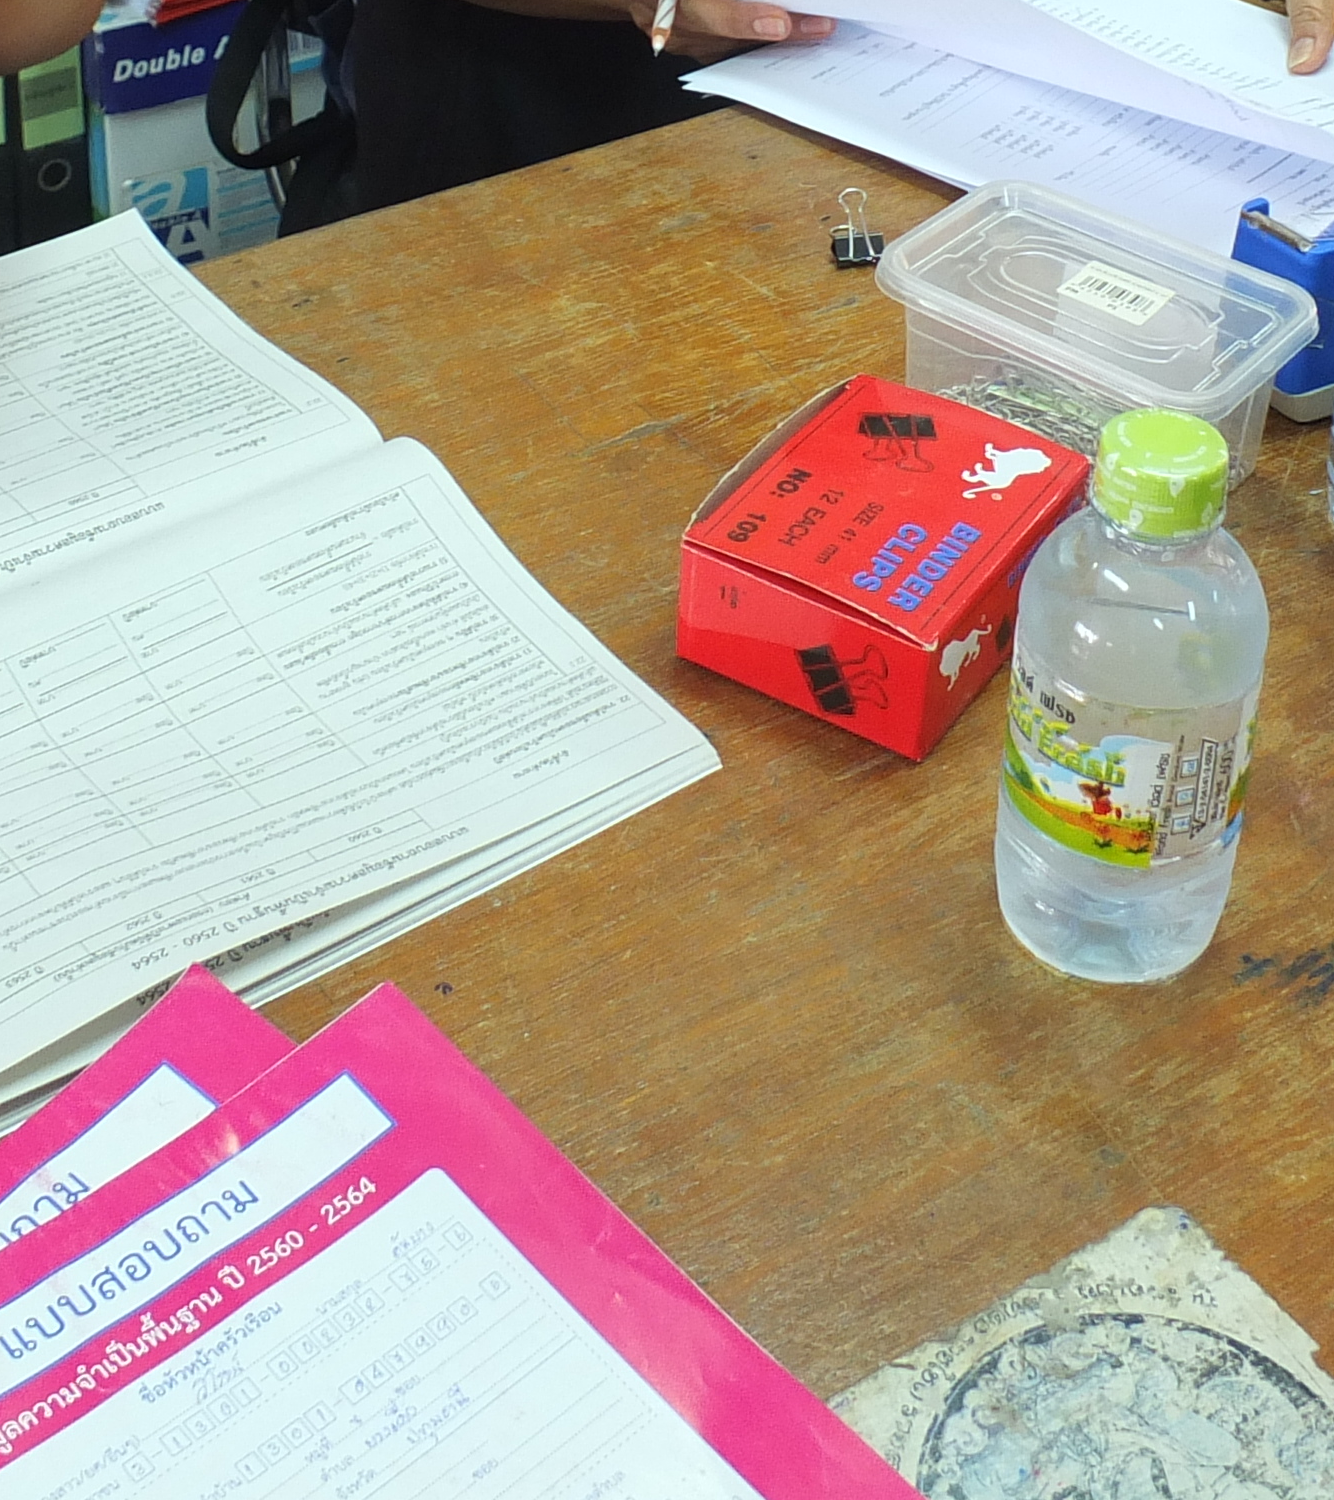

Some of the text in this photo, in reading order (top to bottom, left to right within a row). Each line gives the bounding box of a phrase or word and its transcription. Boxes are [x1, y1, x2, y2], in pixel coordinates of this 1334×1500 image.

[113, 45, 206, 83] Double
[727, 468, 812, 542] NO: 109
[783, 489, 844, 547] 12 EACH
[852, 502, 884, 526] SIZE
[852, 523, 928, 592] CLIPS
[888, 521, 982, 612] BINDER
[129, 946, 169, 971] 2564
[182, 925, 220, 948] 2560
[219, 1263, 248, 1294] ปี
[246, 1229, 305, 1274] 2560
[322, 1176, 377, 1222] 2564
